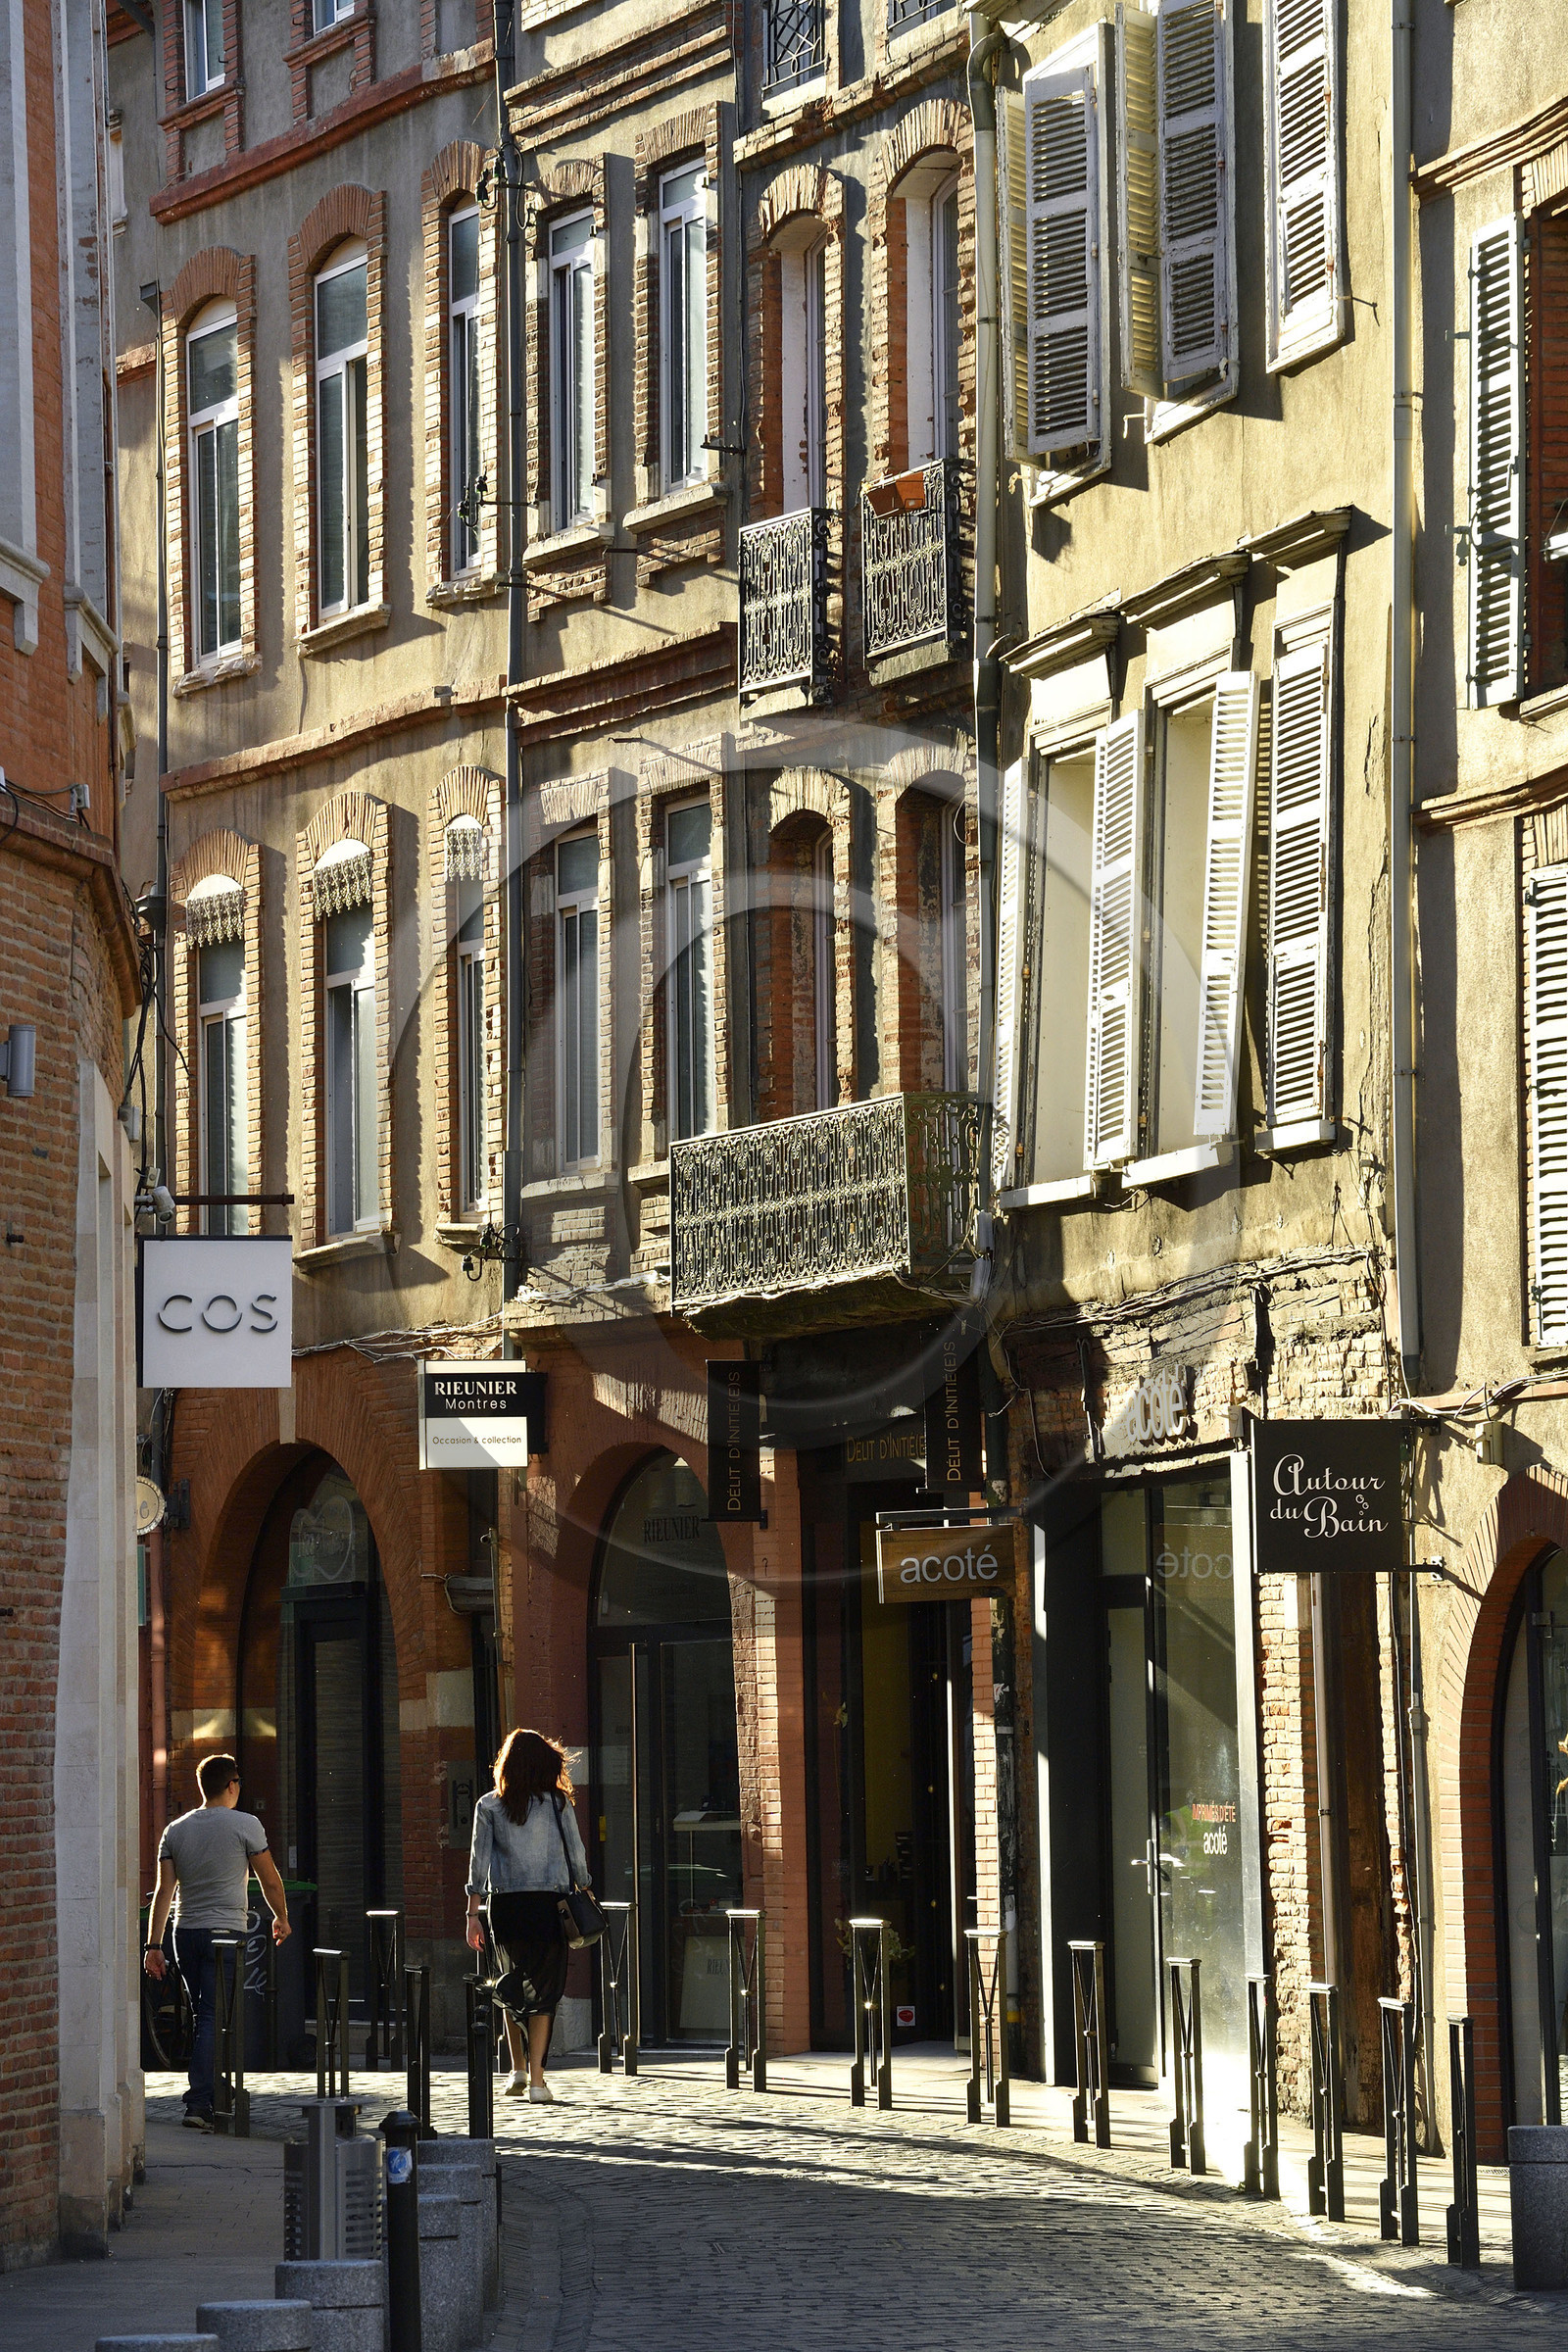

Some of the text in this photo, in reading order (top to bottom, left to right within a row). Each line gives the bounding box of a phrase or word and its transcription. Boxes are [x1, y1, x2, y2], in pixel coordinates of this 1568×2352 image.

[157, 1293, 278, 1334] COS
[434, 1381, 517, 1396] RIEUNIER
[445, 1397, 508, 1410] Montres
[431, 1436, 472, 1446] Occasion
[481, 1436, 522, 1445] collection
[946, 1437, 962, 1482] DÉLIT
[726, 1466, 742, 1511] DÉLIT
[1272, 1453, 1386, 1496] Autour
[644, 1516, 700, 1543] RIEUNIER
[1269, 1495, 1389, 1539] du Bain
[900, 1544, 999, 1584] acoté
[1203, 1825, 1228, 1854] acoté
